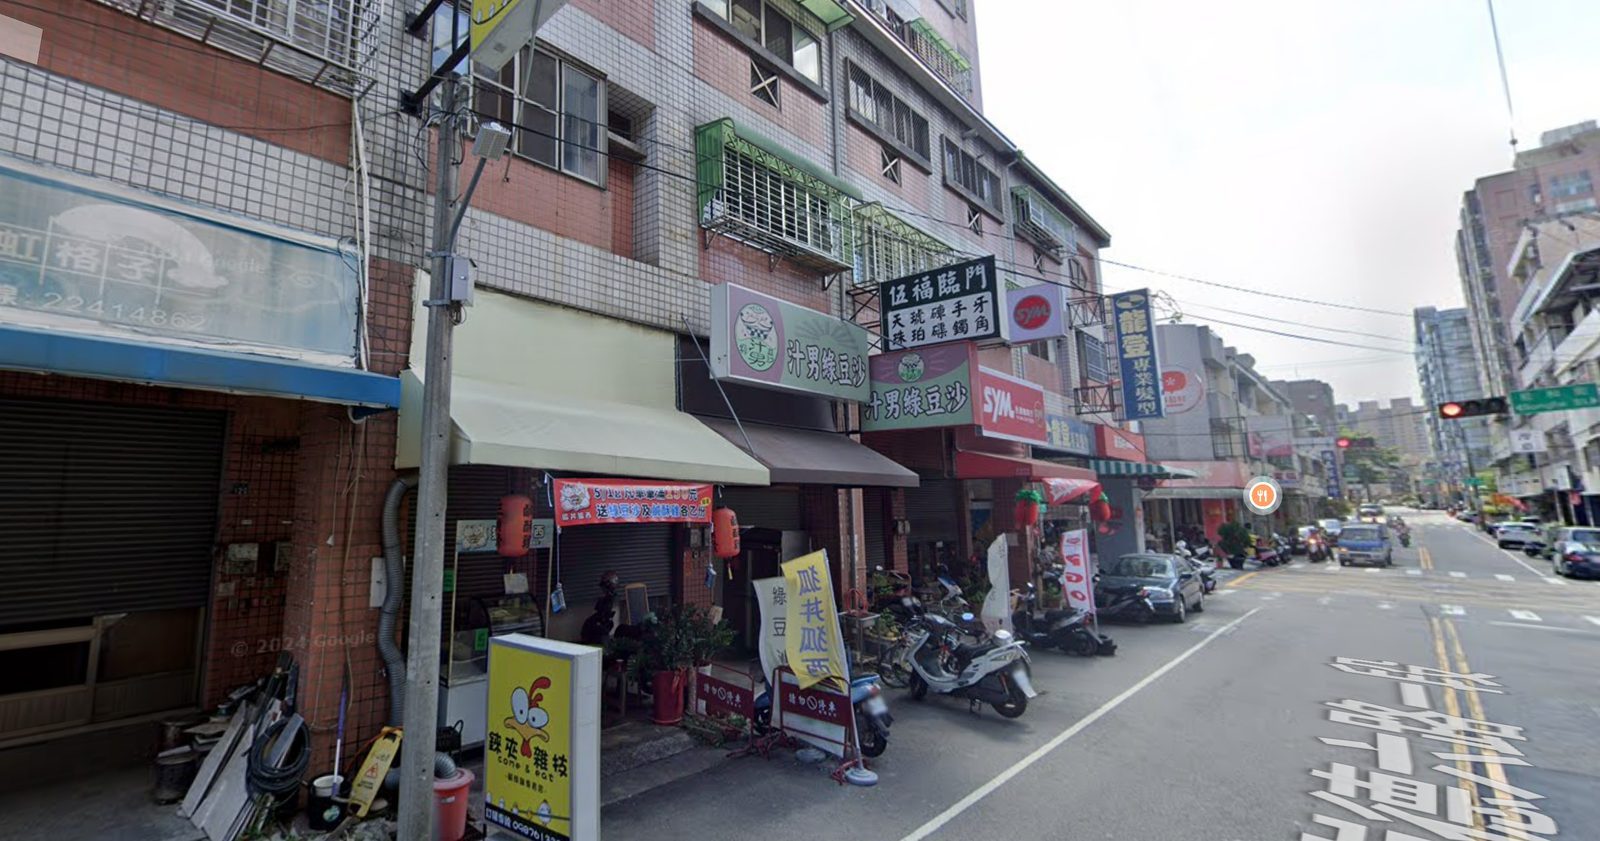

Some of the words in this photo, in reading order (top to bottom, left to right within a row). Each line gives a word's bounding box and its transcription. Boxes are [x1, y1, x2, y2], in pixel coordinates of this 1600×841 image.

[889, 263, 987, 307] 伍福臨門
[1015, 306, 1050, 324] SYM
[787, 340, 867, 388] 汁男綠豆沙
[865, 382, 968, 421] 汁男綠豆沙
[983, 386, 1015, 423] SYM
[497, 756, 521, 769] come
[535, 770, 554, 783] eat
